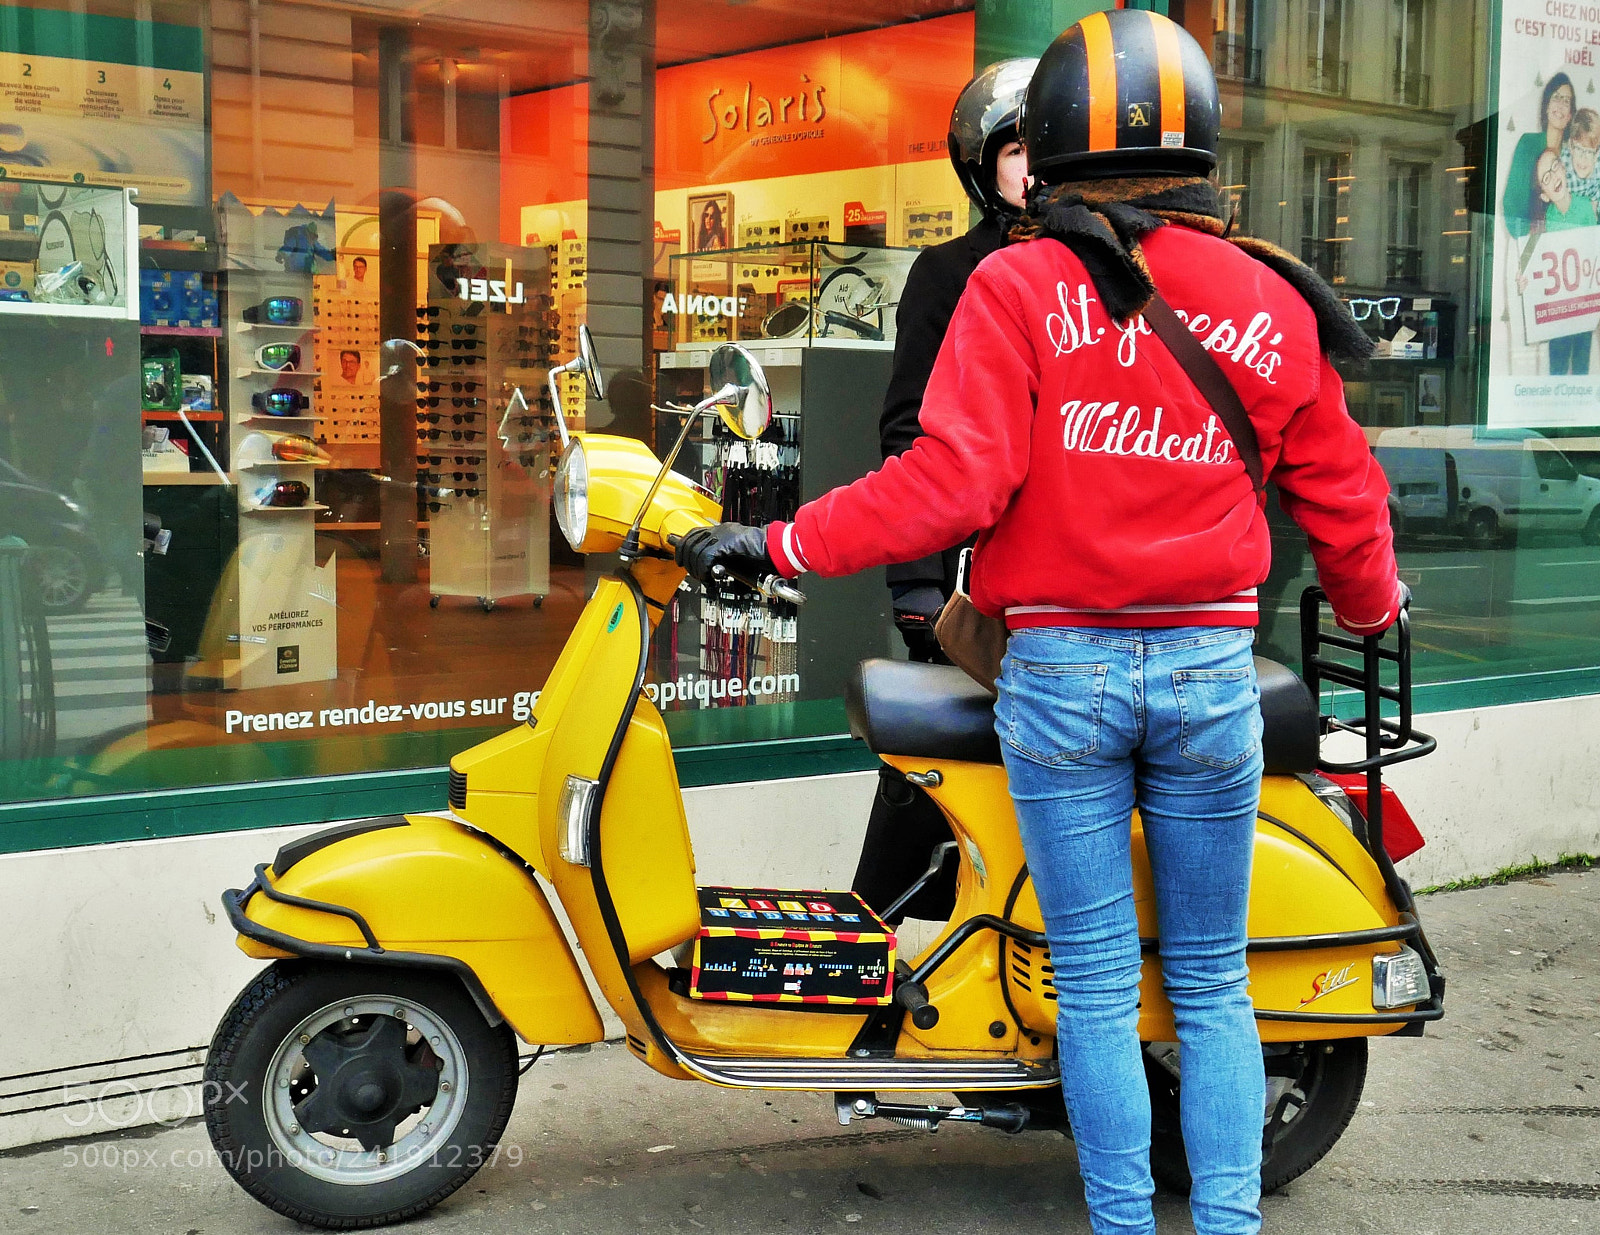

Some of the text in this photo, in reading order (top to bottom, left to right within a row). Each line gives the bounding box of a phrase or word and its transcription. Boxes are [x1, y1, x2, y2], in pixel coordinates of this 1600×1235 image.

[1546, 0, 1576, 19] CHEZ
[1514, 17, 1546, 37] C'EST
[1550, 23, 1580, 42] TOUS
[1564, 46, 1595, 66] NOËL
[22, 63, 32, 77] 2
[97, 70, 106, 84] 3
[162, 78, 172, 91] 4
[701, 73, 826, 144] Solaris
[908, 142, 925, 154] THE
[1046, 281, 1105, 358] St.
[1060, 400, 1234, 464] Wildcats
[268, 610, 309, 621] AMÉLIOREZ
[252, 619, 323, 632] VOS PERFORMANCES
[225, 709, 314, 734] Prenez
[319, 700, 465, 727] rendez-vous
[471, 697, 507, 714] sur
